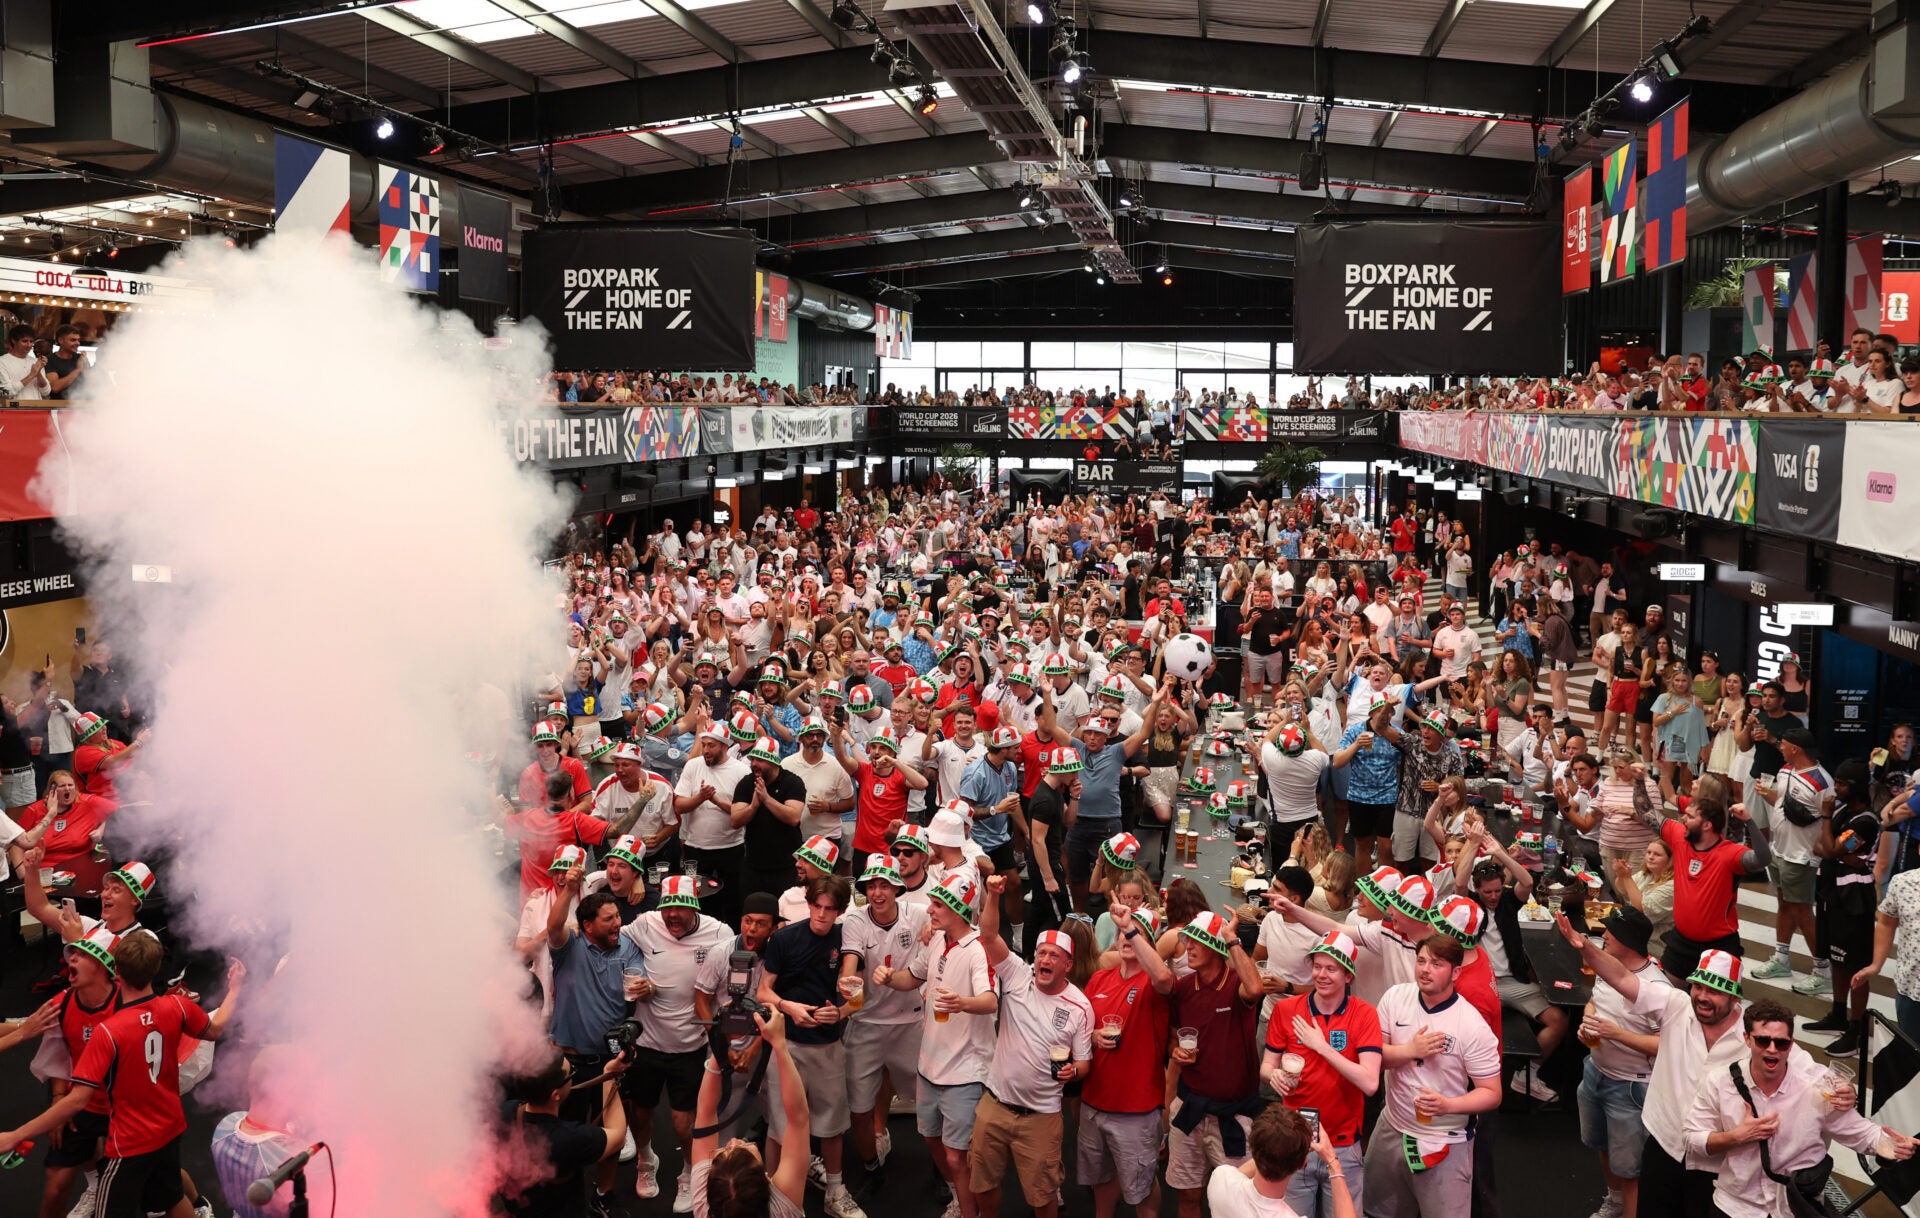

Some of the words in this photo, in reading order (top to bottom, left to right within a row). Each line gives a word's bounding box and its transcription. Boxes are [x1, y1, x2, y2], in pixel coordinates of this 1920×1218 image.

[464, 226, 503, 252] Klarna
[36, 270, 73, 289] COCA
[89, 277, 124, 294] COLA
[564, 268, 659, 288] BOXPARK
[1345, 263, 1456, 285] BOXPARK
[606, 289, 662, 308] HOME
[665, 289, 692, 308] OF
[1393, 287, 1459, 308] HOME
[1462, 287, 1493, 308] OF
[564, 311, 602, 330] THE
[606, 311, 643, 330] FAN
[1345, 309, 1388, 331] THE
[1393, 309, 1436, 331] FAN
[899, 412, 923, 420] WORLD
[1272, 415, 1299, 423] WORLD
[973, 424, 1001, 433] CARLING
[1290, 423, 1336, 431] SCREENINGS
[1349, 427, 1378, 436] CARLING
[513, 420, 541, 461] OF
[543, 418, 582, 459] THE
[584, 417, 618, 456] FAN
[1549, 427, 1607, 479] BOXPARK
[1077, 464, 1114, 480] BAR
[1773, 453, 1798, 479] VISA
[1869, 479, 1893, 495] Klarna
[0, 580, 32, 599] EESE
[33, 574, 75, 593] WHEEL
[1750, 580, 1767, 597] SIDES
[1888, 625, 1919, 650] NANNY
[145, 1030, 163, 1085] 9
